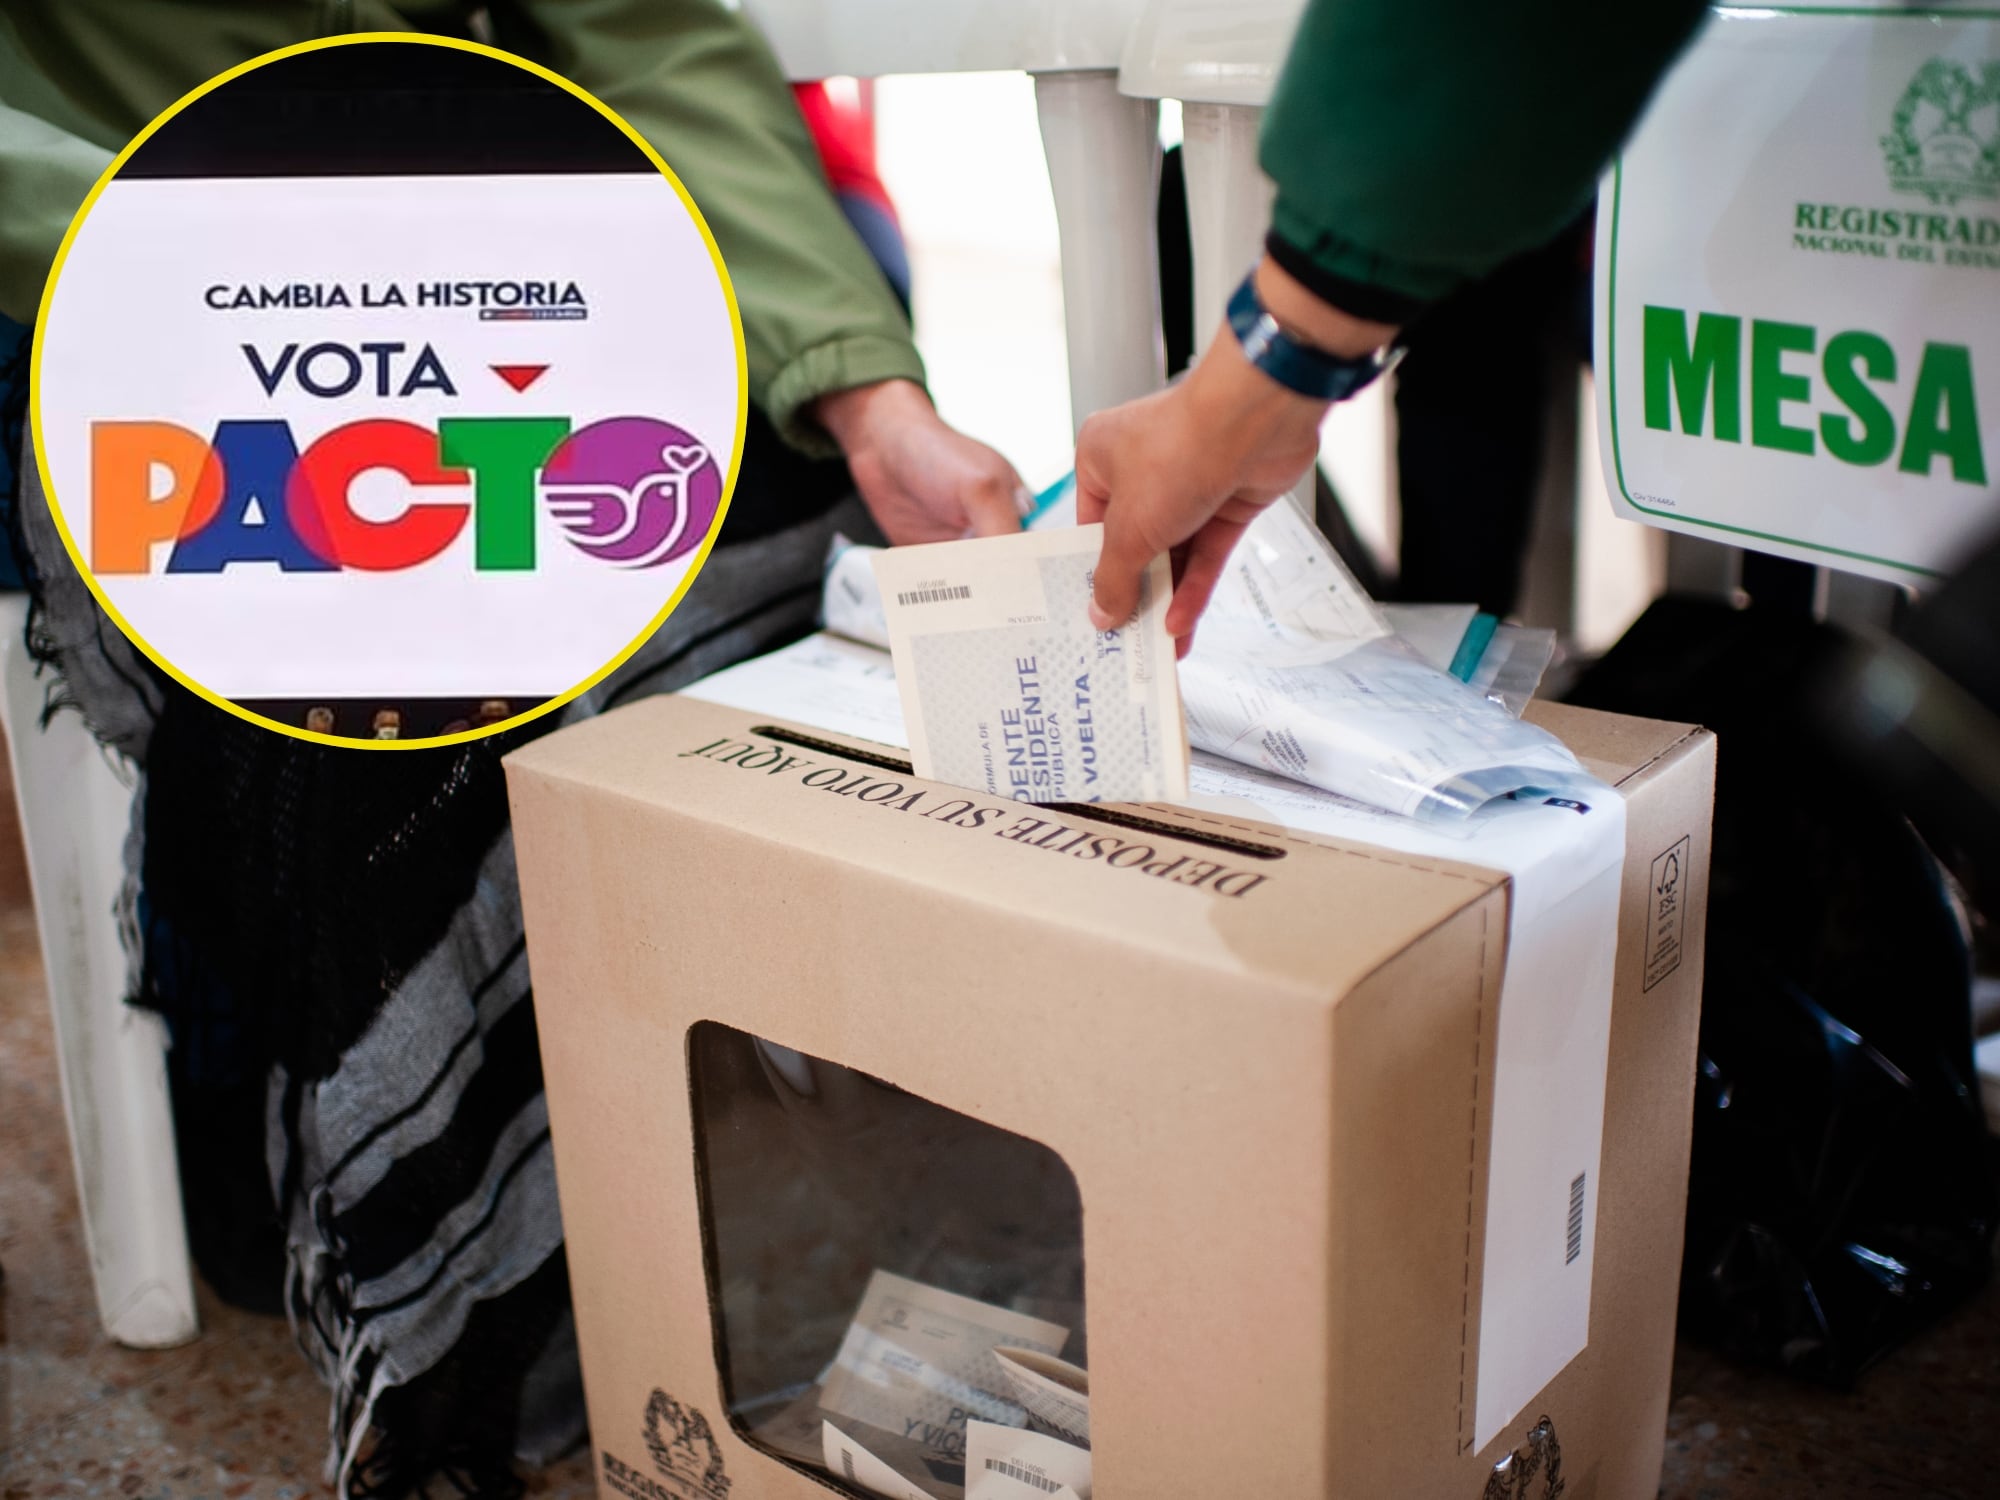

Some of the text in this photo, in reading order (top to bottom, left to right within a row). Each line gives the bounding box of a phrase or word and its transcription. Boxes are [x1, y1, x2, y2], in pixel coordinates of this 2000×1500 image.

[1793, 233, 1888, 259] NACIONAL
[1897, 244, 1937, 264] DEL
[204, 281, 586, 310] CAMBIA LA HISTORIA
[241, 341, 459, 399] VOTA
[1643, 304, 1988, 487] MESA
[90, 416, 724, 573] PACTO
[1075, 673, 1099, 784] VUELTA
[801, 768, 928, 812] VOTO
[918, 799, 1007, 829] SU
[995, 816, 1269, 897] DEPOSITE
